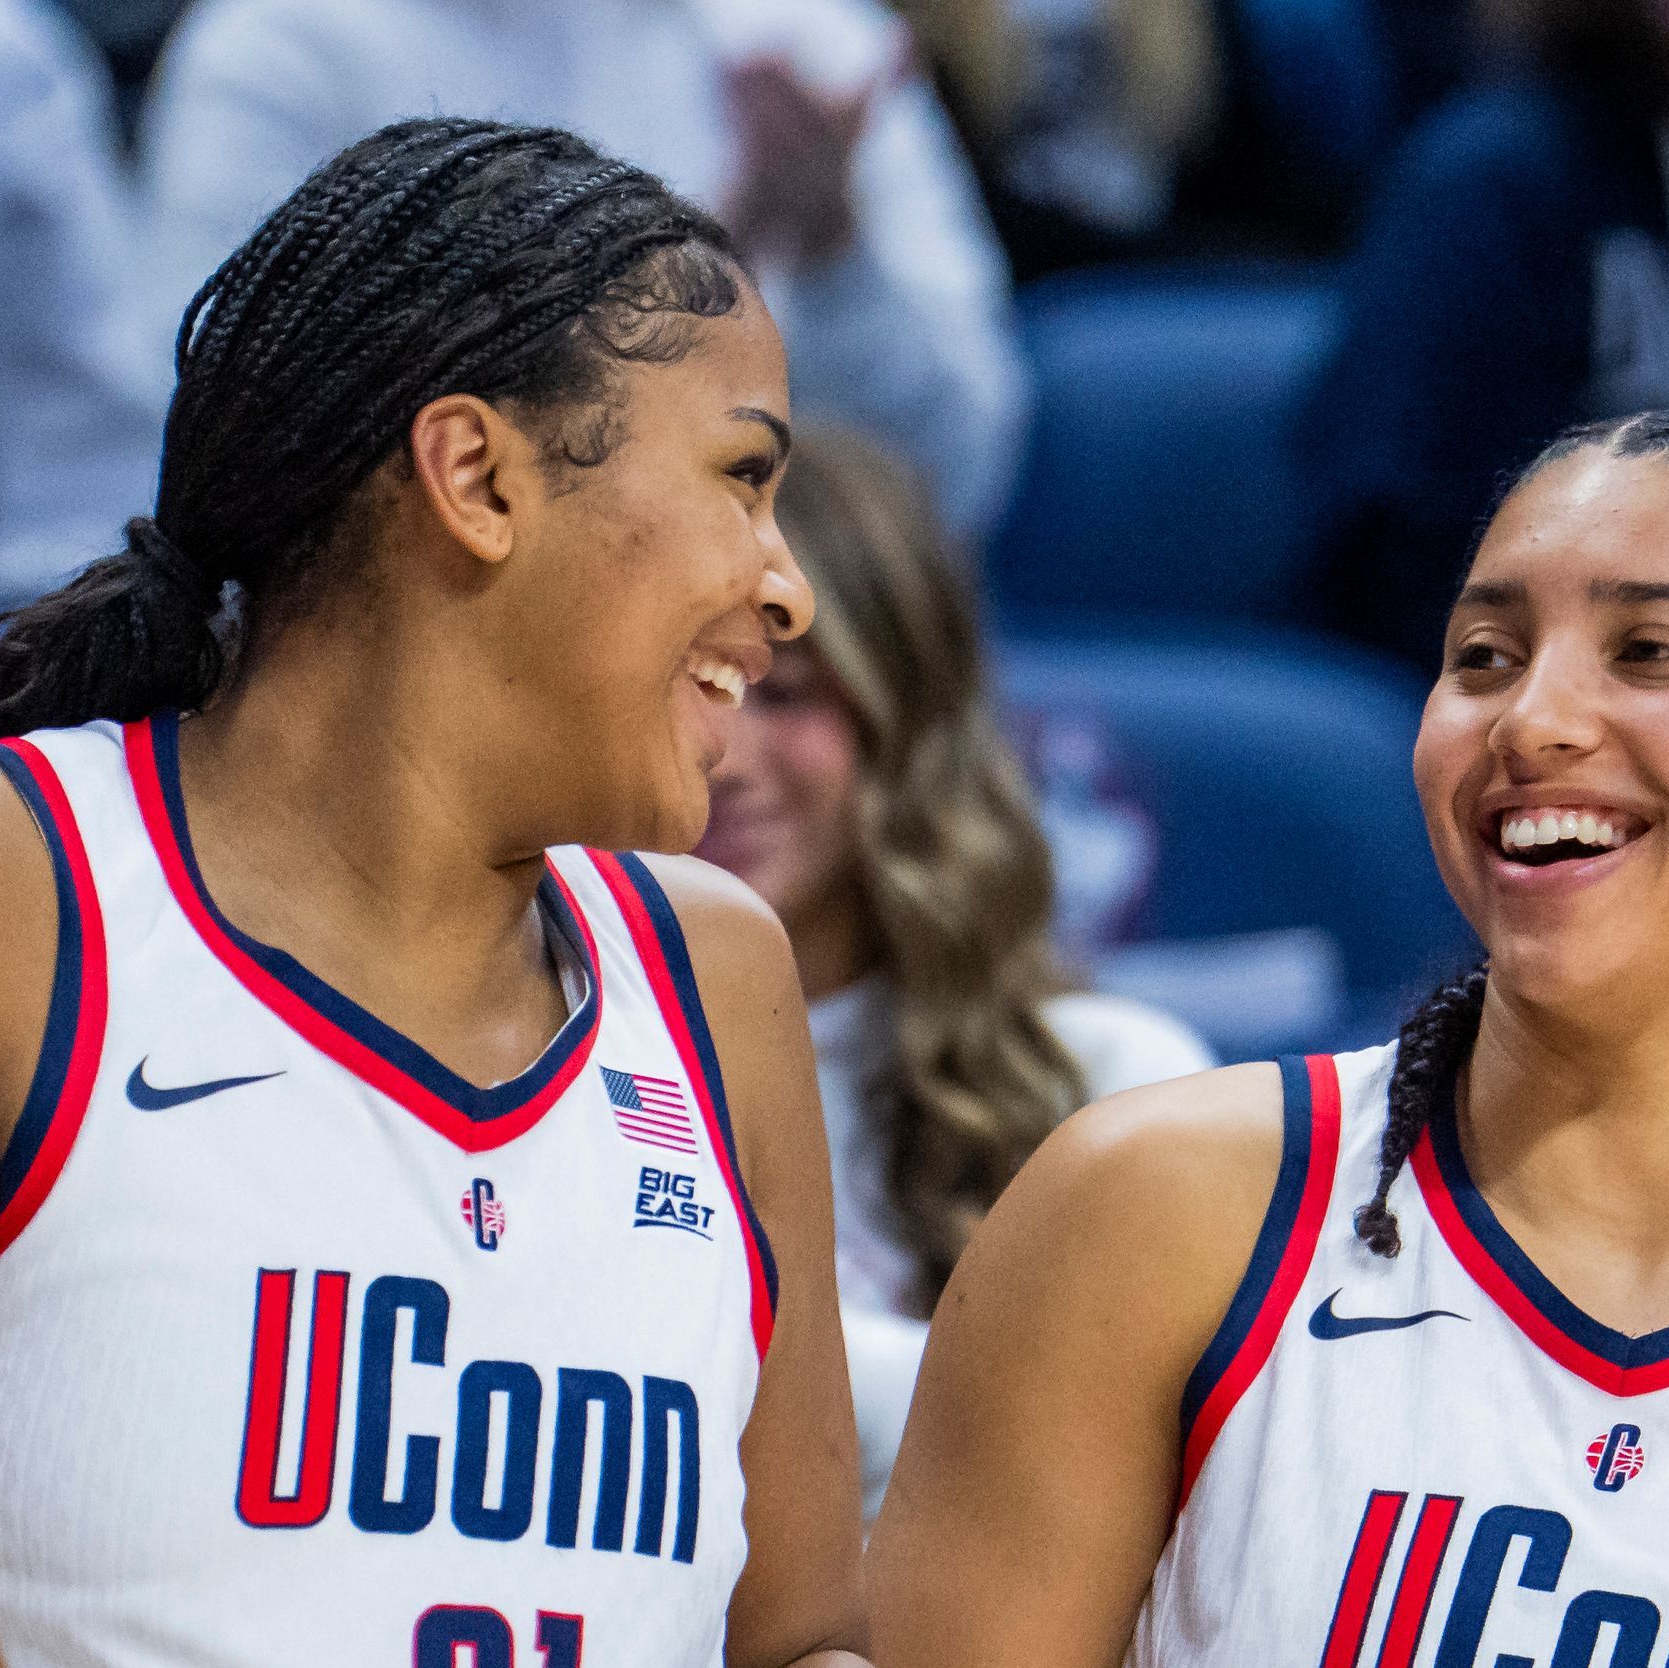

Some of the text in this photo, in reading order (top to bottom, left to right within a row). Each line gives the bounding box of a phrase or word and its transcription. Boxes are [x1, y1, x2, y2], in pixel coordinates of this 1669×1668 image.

[639, 1166, 696, 1200] BIG
[635, 1192, 715, 1229] EAST
[234, 1266, 701, 1565] UConn
